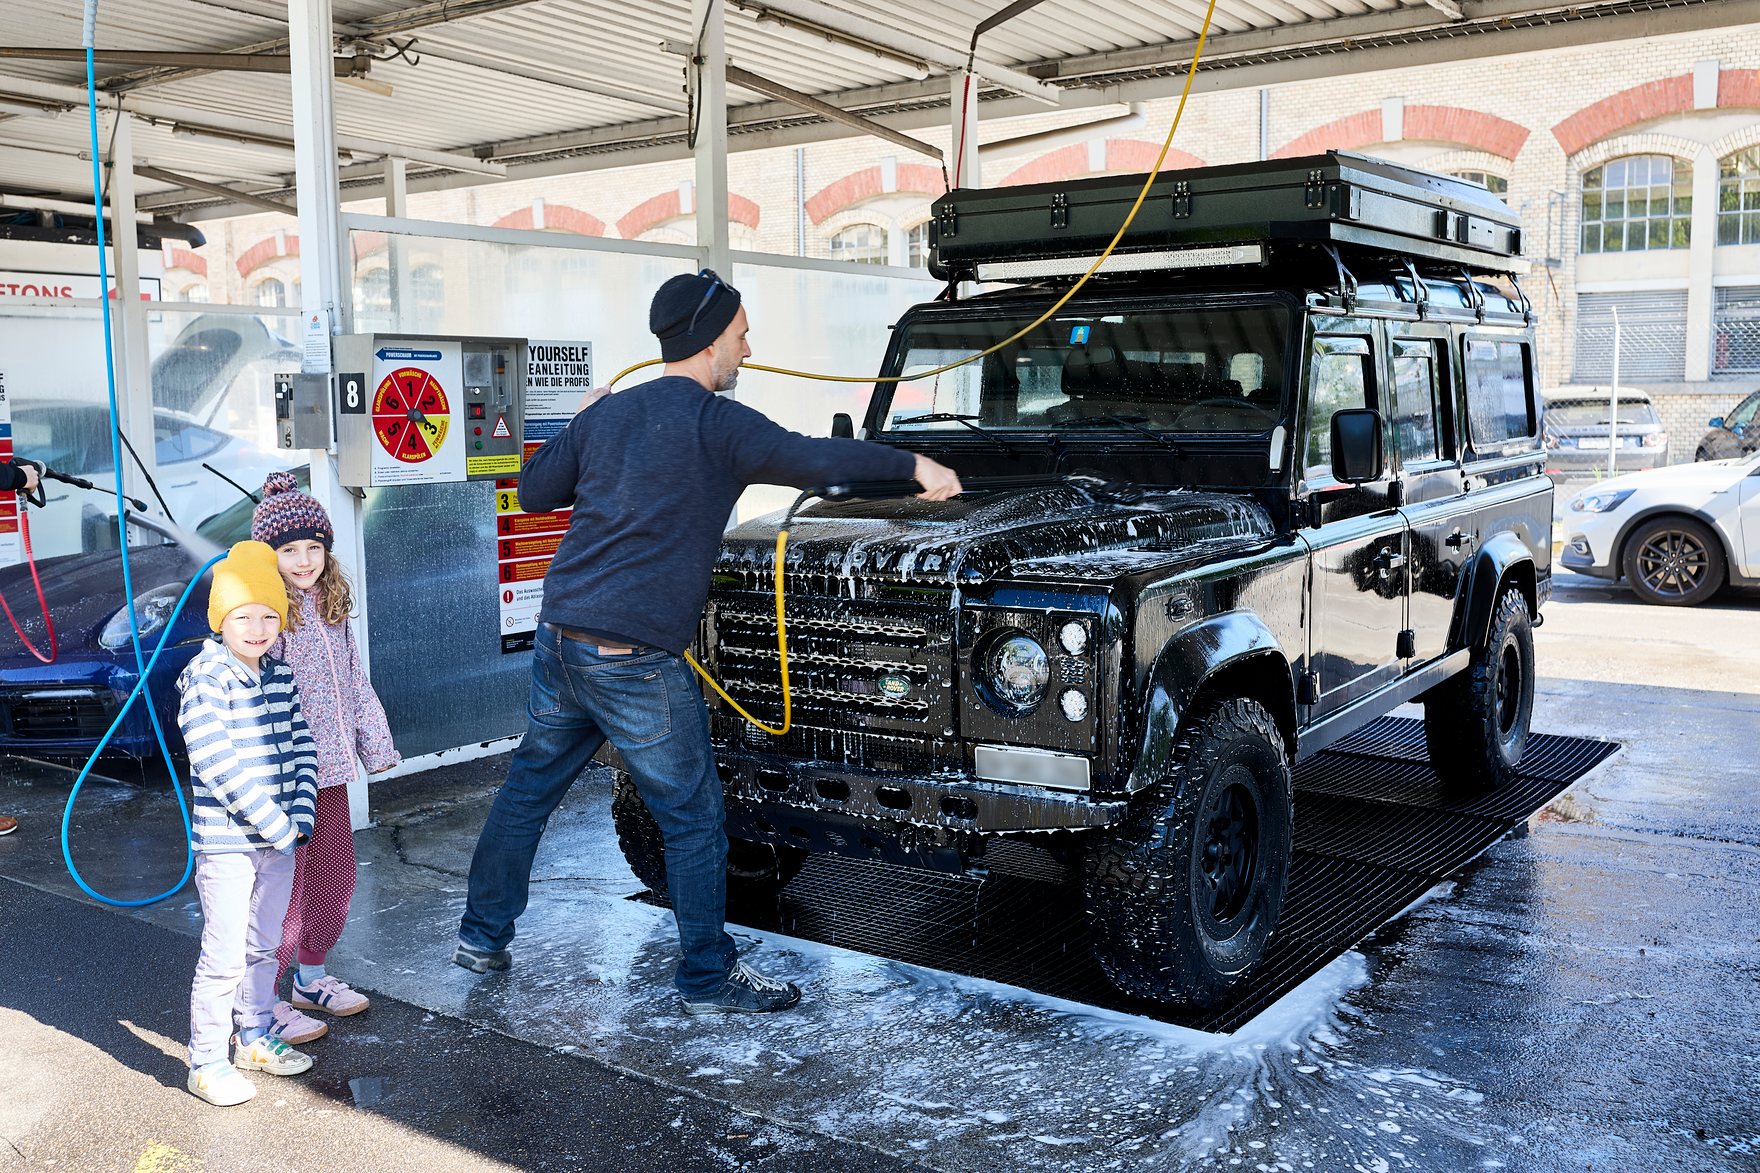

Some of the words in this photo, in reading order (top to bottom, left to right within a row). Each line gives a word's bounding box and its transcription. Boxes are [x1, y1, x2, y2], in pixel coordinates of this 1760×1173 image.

[0, 283, 73, 298] TONS
[528, 346, 588, 362] YOURSELF
[527, 363, 589, 376] EANLEITUNG
[406, 381, 413, 398] 1
[526, 377, 533, 387] N
[535, 377, 549, 387] WIE
[551, 377, 563, 387] DIE
[564, 377, 590, 387] PROFIS
[346, 380, 359, 408] 8
[385, 395, 399, 410] 6
[421, 395, 436, 410] 2
[387, 421, 401, 436] 5
[424, 421, 437, 435] 3
[285, 433, 292, 448] 5
[378, 430, 390, 446] WACHS
[408, 433, 417, 450] 4
[402, 452, 427, 460] KLARSPÜLEN
[501, 493, 509, 510] 3
[502, 517, 511, 533] 4
[502, 541, 511, 557] 5
[503, 564, 512, 581] 6
